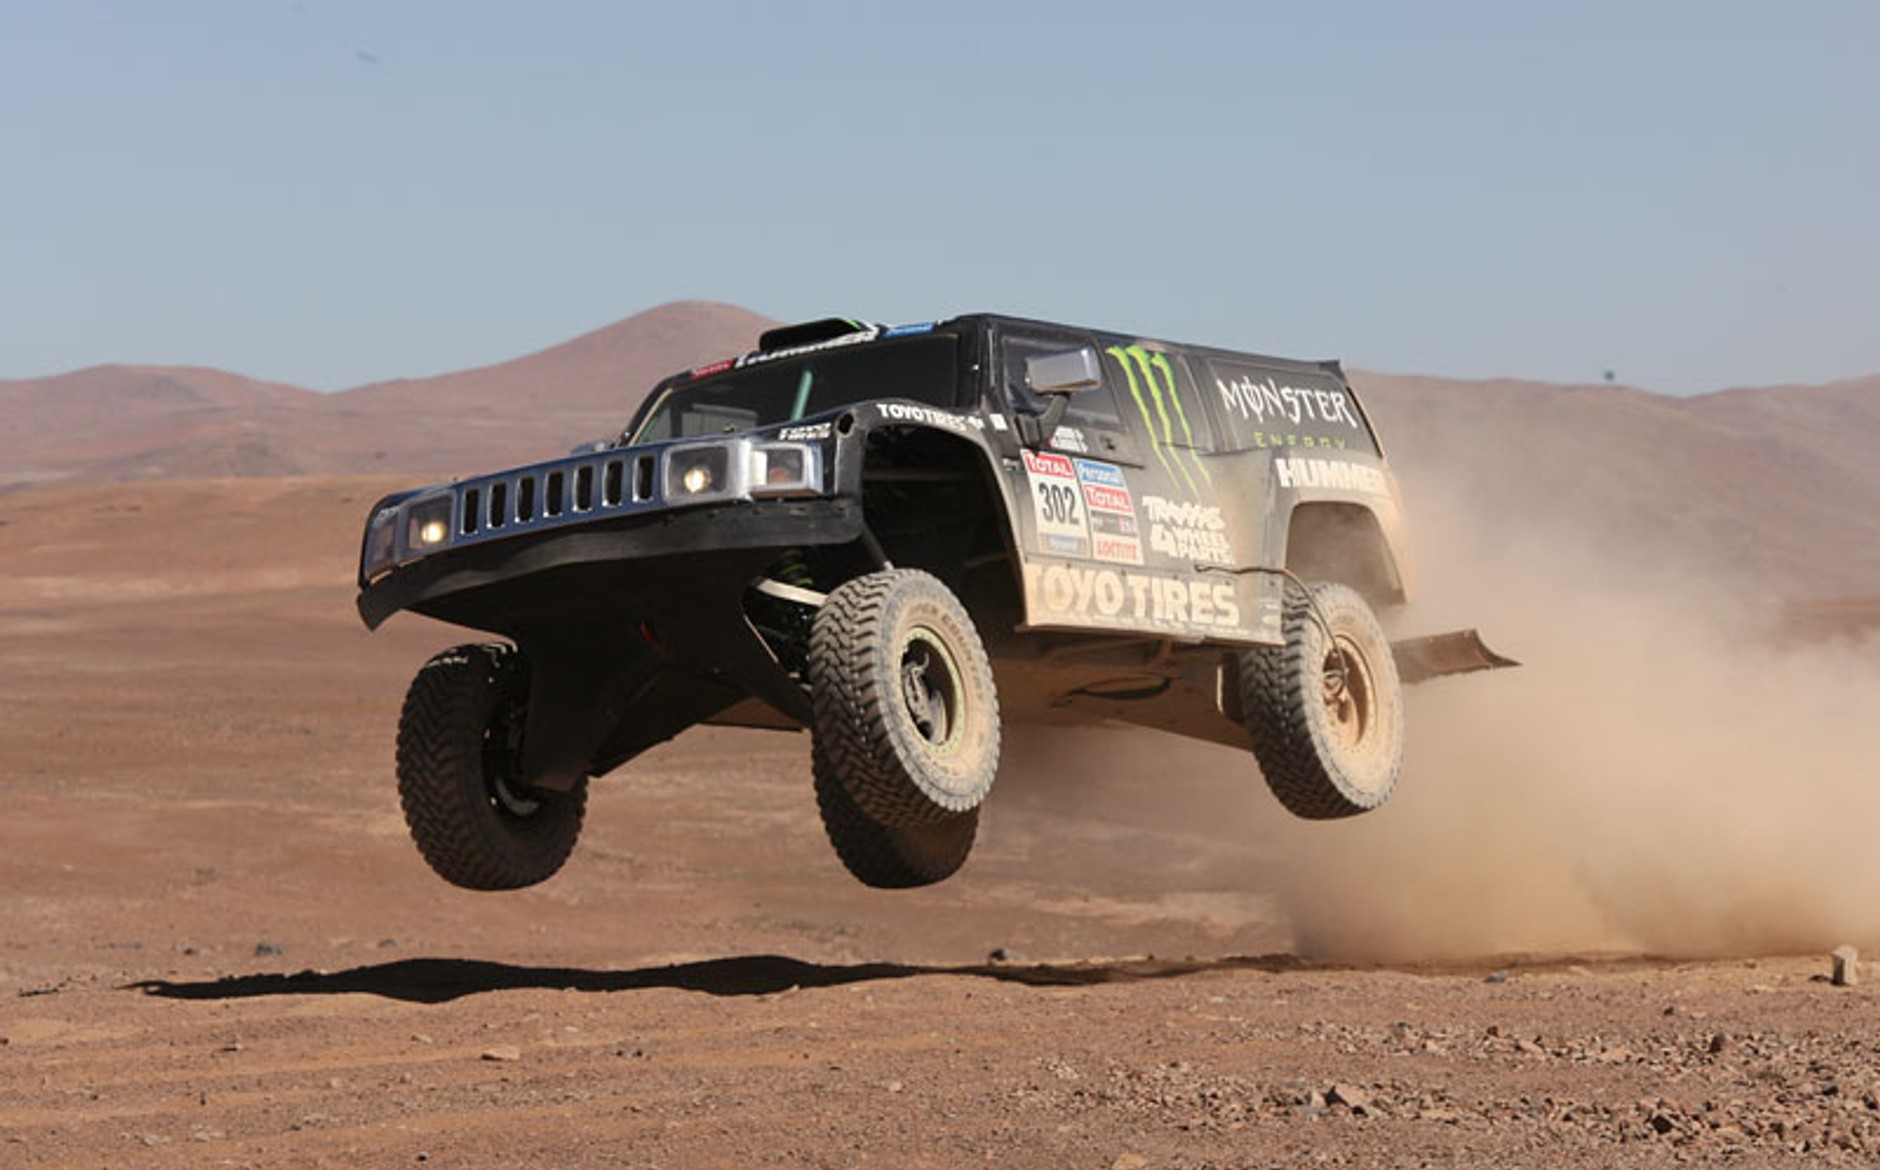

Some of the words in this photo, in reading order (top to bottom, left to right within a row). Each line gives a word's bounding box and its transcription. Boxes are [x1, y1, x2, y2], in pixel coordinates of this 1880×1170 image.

[1216, 376, 1358, 429] MONSTER
[1254, 432, 1346, 448] ENERGY
[1028, 453, 1074, 478] TOTAL
[1038, 482, 1080, 525] 302
[1086, 486, 1132, 511] TOTAL
[1128, 575, 1241, 627] TIRES
